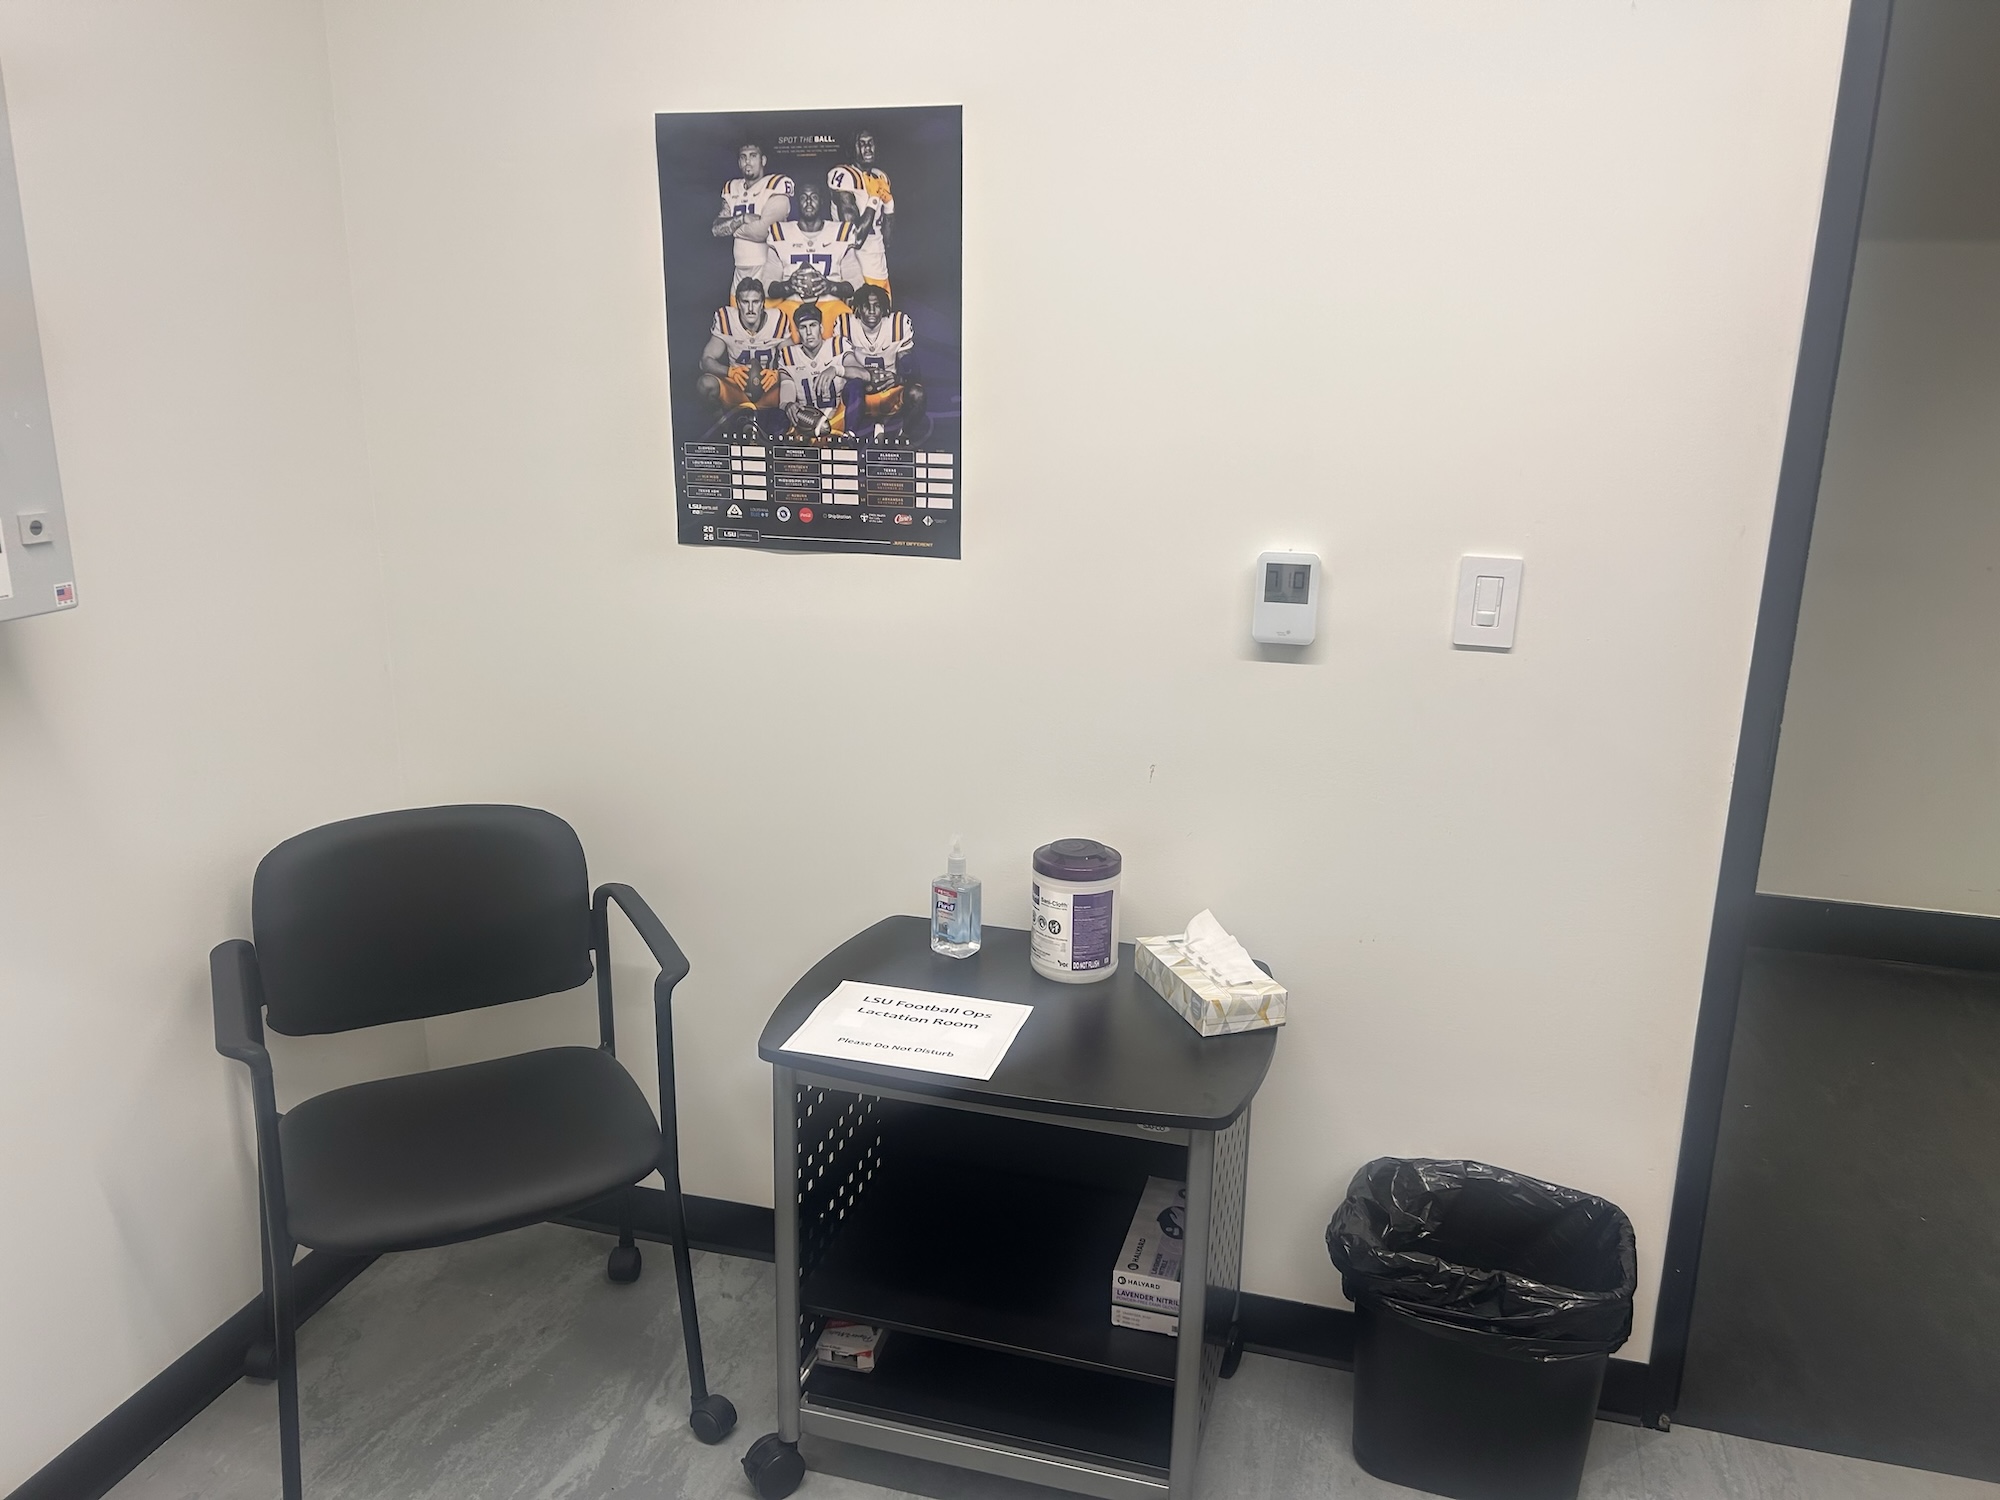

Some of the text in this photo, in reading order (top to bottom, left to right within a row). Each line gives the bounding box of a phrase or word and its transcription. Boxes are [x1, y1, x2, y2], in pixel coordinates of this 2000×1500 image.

[778, 136, 797, 144] SPOT
[799, 135, 813, 144] THE
[831, 170, 845, 188] 14
[790, 253, 832, 278] 77
[768, 434, 804, 442] COME
[862, 995, 993, 1019] LSU Football Ops
[857, 1006, 979, 1030] Lactation Room
[838, 1036, 872, 1047] Please
[892, 1044, 912, 1052] Not
[914, 1046, 955, 1058] Disturb
[1132, 1237, 1146, 1263] HALYARD
[1127, 1279, 1161, 1290] HALYARD
[1116, 1289, 1180, 1306] LAVENDER NITRIL
